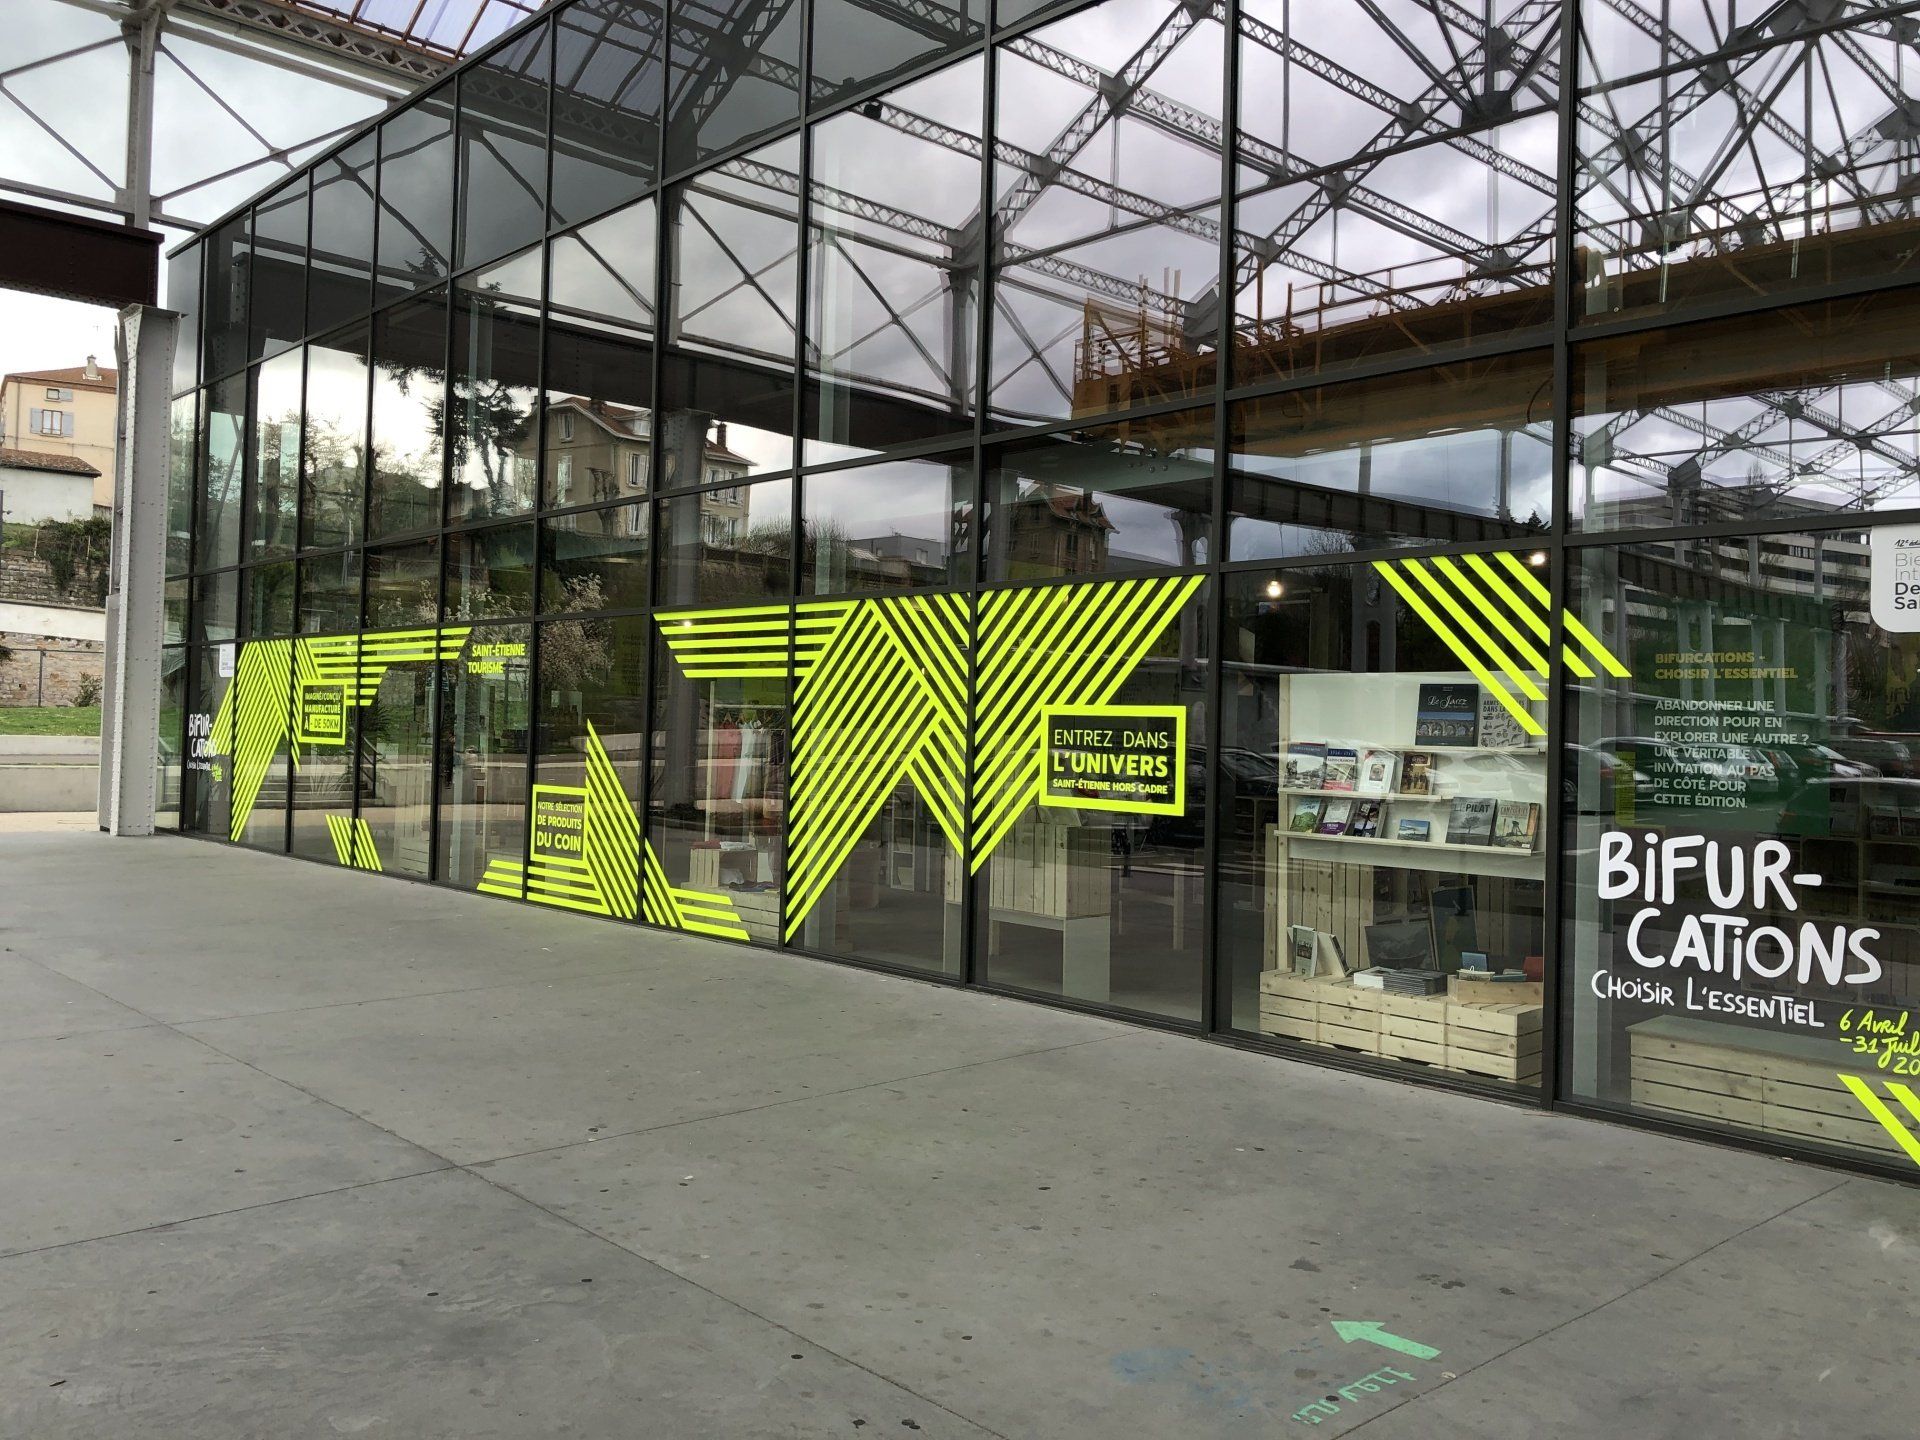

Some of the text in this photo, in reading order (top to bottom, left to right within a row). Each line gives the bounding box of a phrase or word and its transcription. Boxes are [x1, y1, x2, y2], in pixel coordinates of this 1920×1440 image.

[1895, 582, 1920, 596] De
[1894, 596, 1920, 610] Sa
[472, 641, 526, 657] SAINT-ÉTIENNE
[1655, 652, 1754, 664] BIFURCATIONS
[467, 661, 504, 674] TOURISME
[1655, 667, 1798, 680] CHOISIR L'ESSENTIEL
[1655, 700, 1775, 712] ABANDONNER UNE
[1654, 715, 1782, 728] DIRECTION POUR EN
[1054, 729, 1168, 749] ENTREZ DANS
[1654, 731, 1718, 743] EXPLORER
[1722, 732, 1748, 743] UNE
[1753, 733, 1798, 744] AUTRE
[1654, 746, 1751, 759] UNE VÉRITABLE
[1053, 752, 1168, 778] L'UNIVERS
[1654, 762, 1775, 777] INVITATION AU PAS
[1053, 778, 1168, 795] SAINT-ÉTIENNE HORS CADRE
[1654, 776, 1747, 792] DE CÔTÉ POUR
[538, 801, 583, 814] NOTRE SÉLECTION
[1654, 793, 1748, 808] CETTE ÉDITION.
[1465, 803, 1491, 813] PILAT
[537, 815, 582, 830] DE PRODUITS
[537, 831, 581, 852] DU COIN
[1840, 1008, 1853, 1031] 6
[1893, 1056, 1920, 1076] 20
